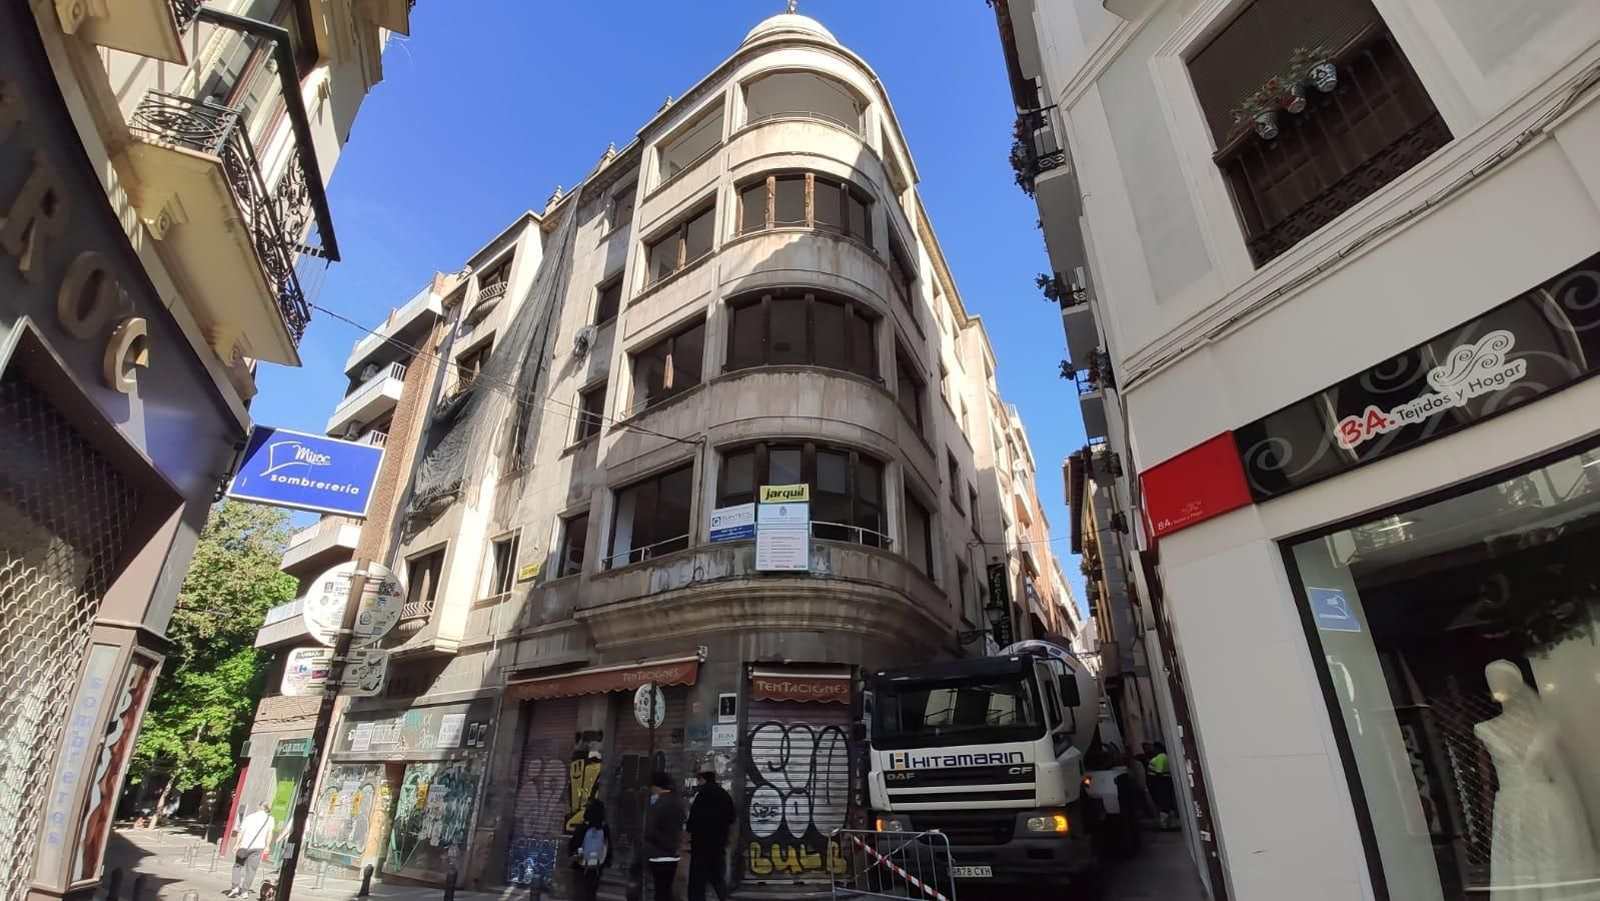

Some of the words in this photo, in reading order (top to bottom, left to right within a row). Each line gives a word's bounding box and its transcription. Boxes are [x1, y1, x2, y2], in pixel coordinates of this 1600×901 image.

[1396, 394, 1451, 421] Tejidos
[1455, 389, 1464, 401] y
[1468, 363, 1522, 392] Hogar
[270, 473, 360, 495] sombrerería
[765, 487, 804, 500] jarquil
[47, 676, 103, 845] sombreros
[887, 773, 915, 781] DAF
[1008, 766, 1033, 775] CF
